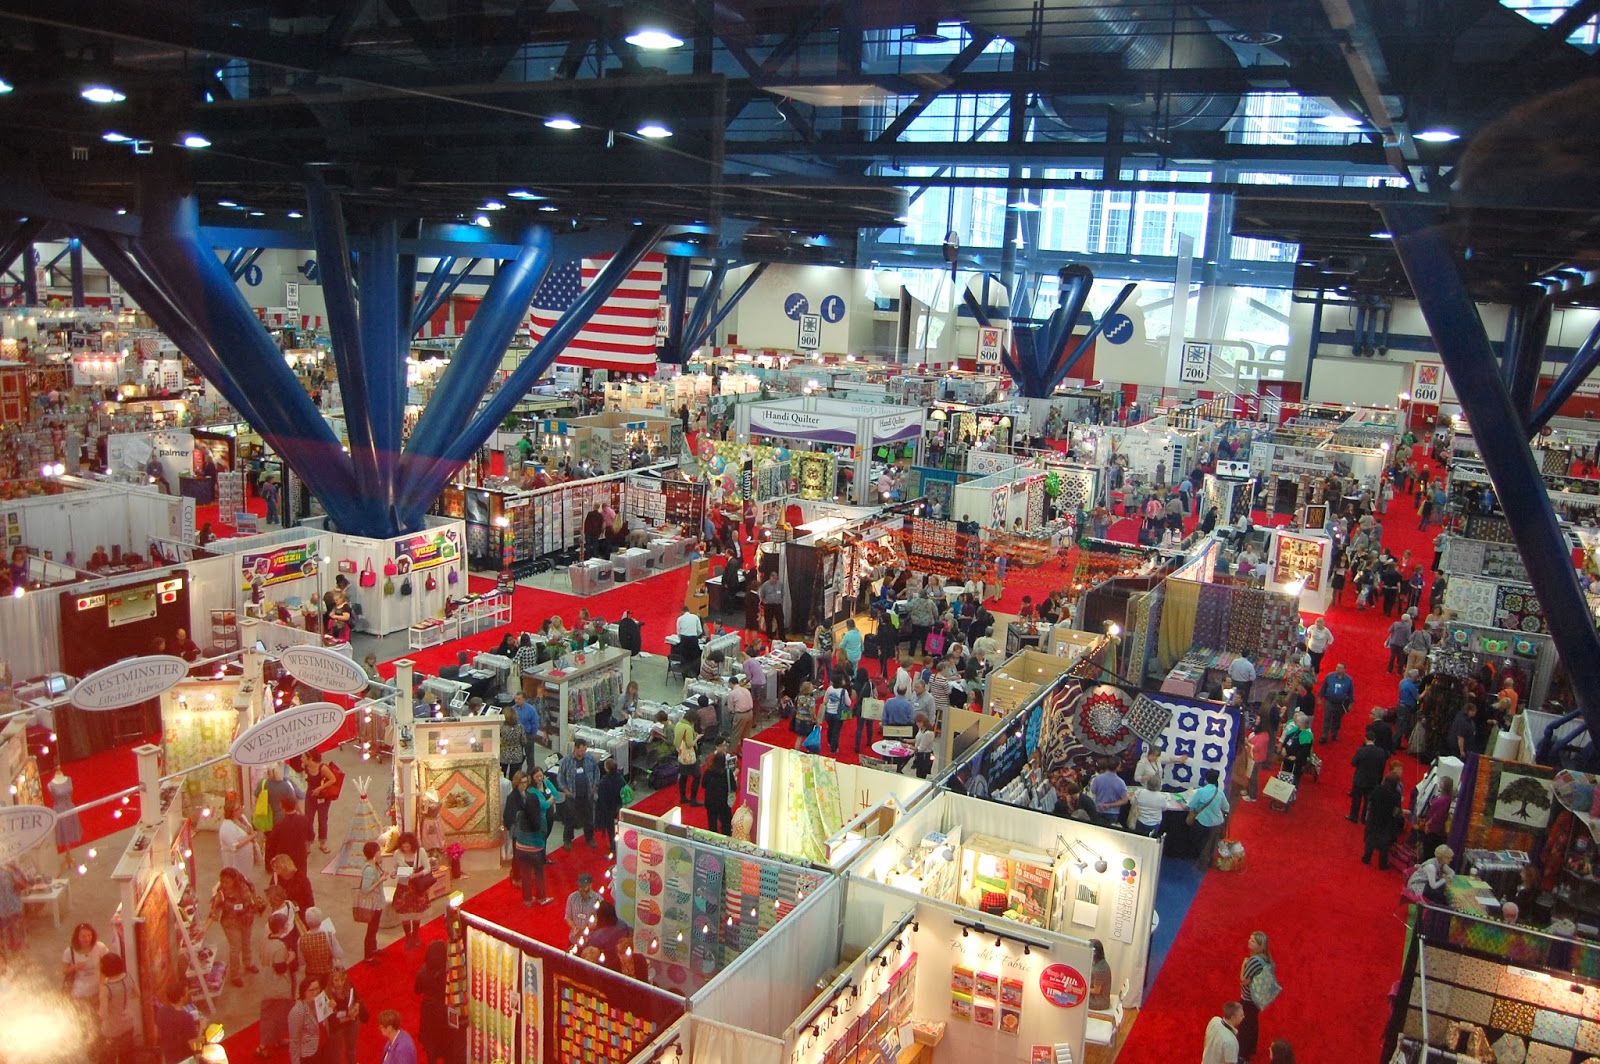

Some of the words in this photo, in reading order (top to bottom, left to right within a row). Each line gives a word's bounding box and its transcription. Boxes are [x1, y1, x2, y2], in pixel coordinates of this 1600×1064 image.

[801, 336, 817, 346] 900
[980, 351, 998, 361] 800
[1185, 367, 1204, 379] 700
[1415, 388, 1437, 400] 600
[765, 410, 790, 421] Handi
[791, 412, 820, 425] Quilter
[879, 418, 892, 428] Handi
[891, 416, 906, 427] Quilter
[159, 448, 190, 458] palmer
[288, 654, 359, 683] WESTMINSTER
[83, 663, 180, 697] WESTMINSTER
[324, 675, 347, 688] Fabrics
[98, 686, 136, 706] Lifestyle
[136, 681, 165, 701] Fabrics
[243, 711, 337, 752] WESTMINSTER
[257, 742, 293, 762] Lifestyle
[294, 732, 323, 752] Fabrics
[1015, 867, 1023, 876] TO
[1023, 870, 1043, 884] SEWING
[1035, 868, 1051, 880] GUIDE
[1122, 884, 1135, 923] MODERN
[995, 955, 1032, 972] Fabric
[840, 977, 869, 1015] QULT
